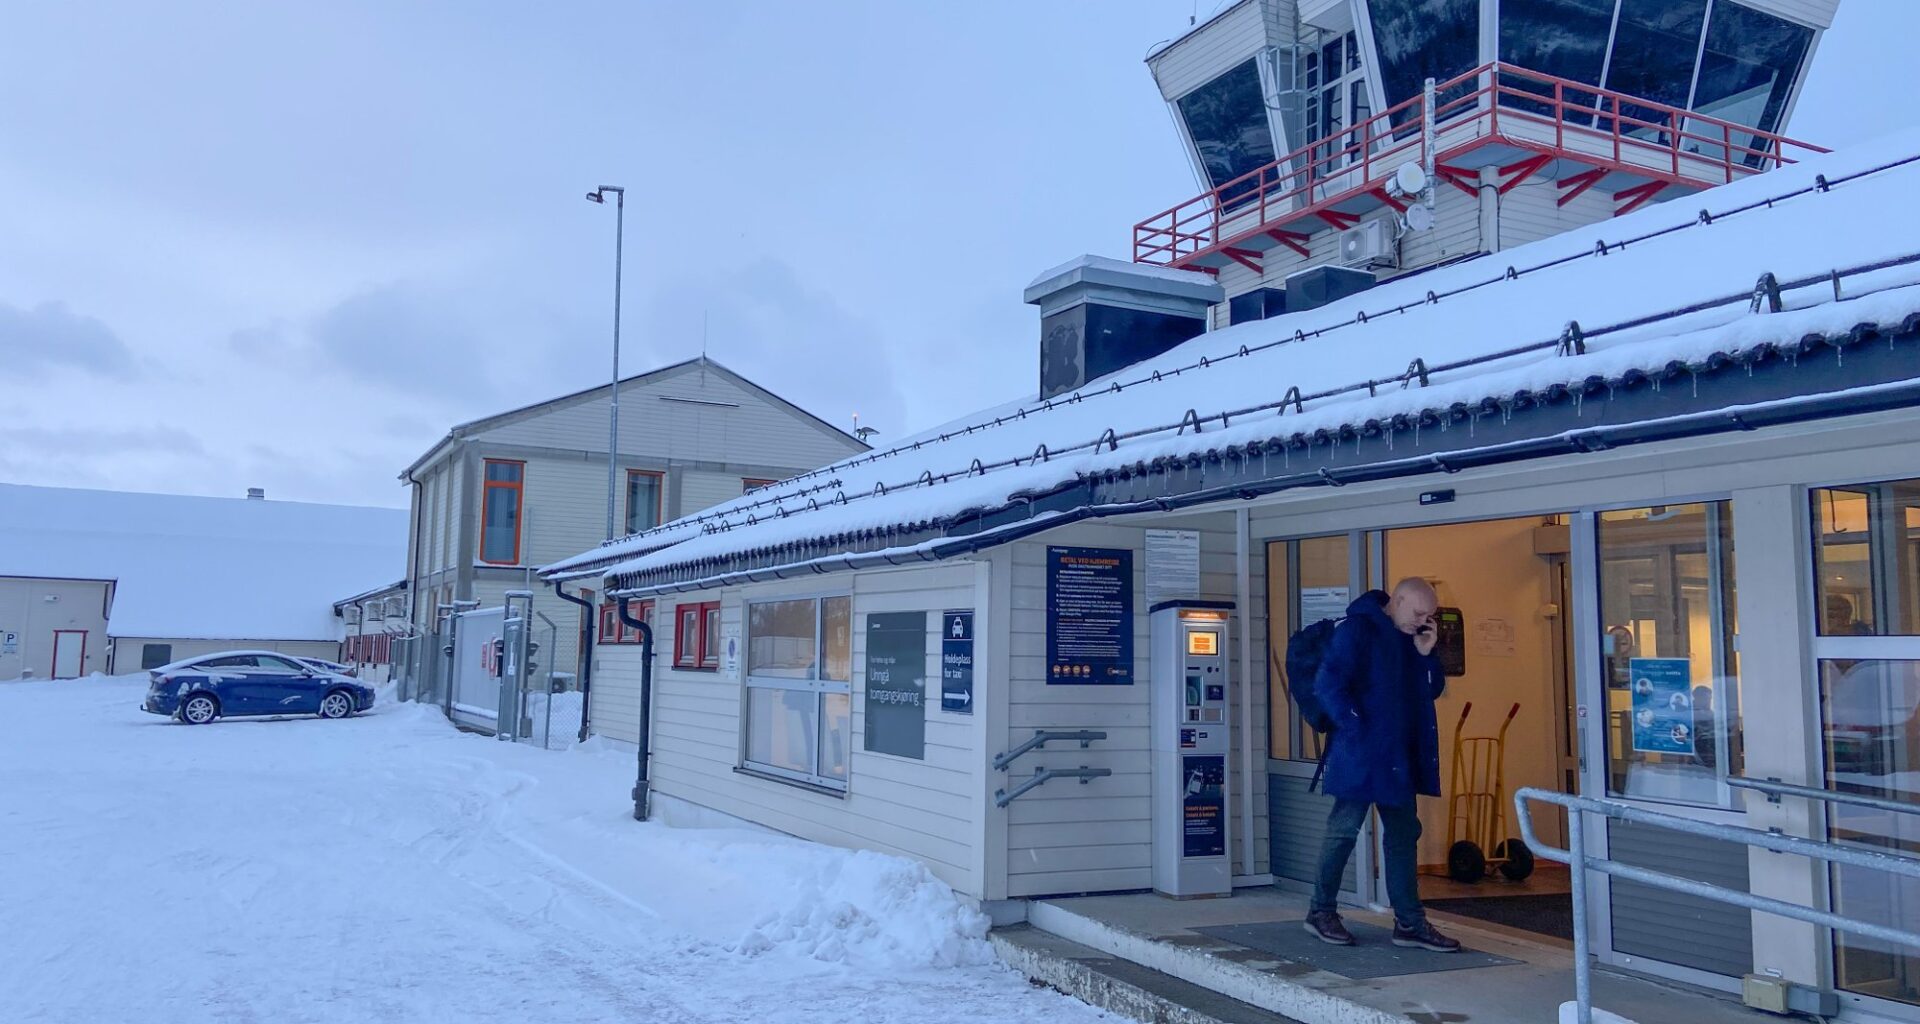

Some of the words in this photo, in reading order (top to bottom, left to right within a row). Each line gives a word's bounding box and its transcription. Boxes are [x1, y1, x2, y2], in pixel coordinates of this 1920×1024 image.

[7, 634, 15, 643] P
[944, 653, 971, 666] Holdeplass
[870, 667, 890, 685] Unngå
[953, 668, 962, 679] taxi
[870, 689, 920, 706] tomgangskjøring
